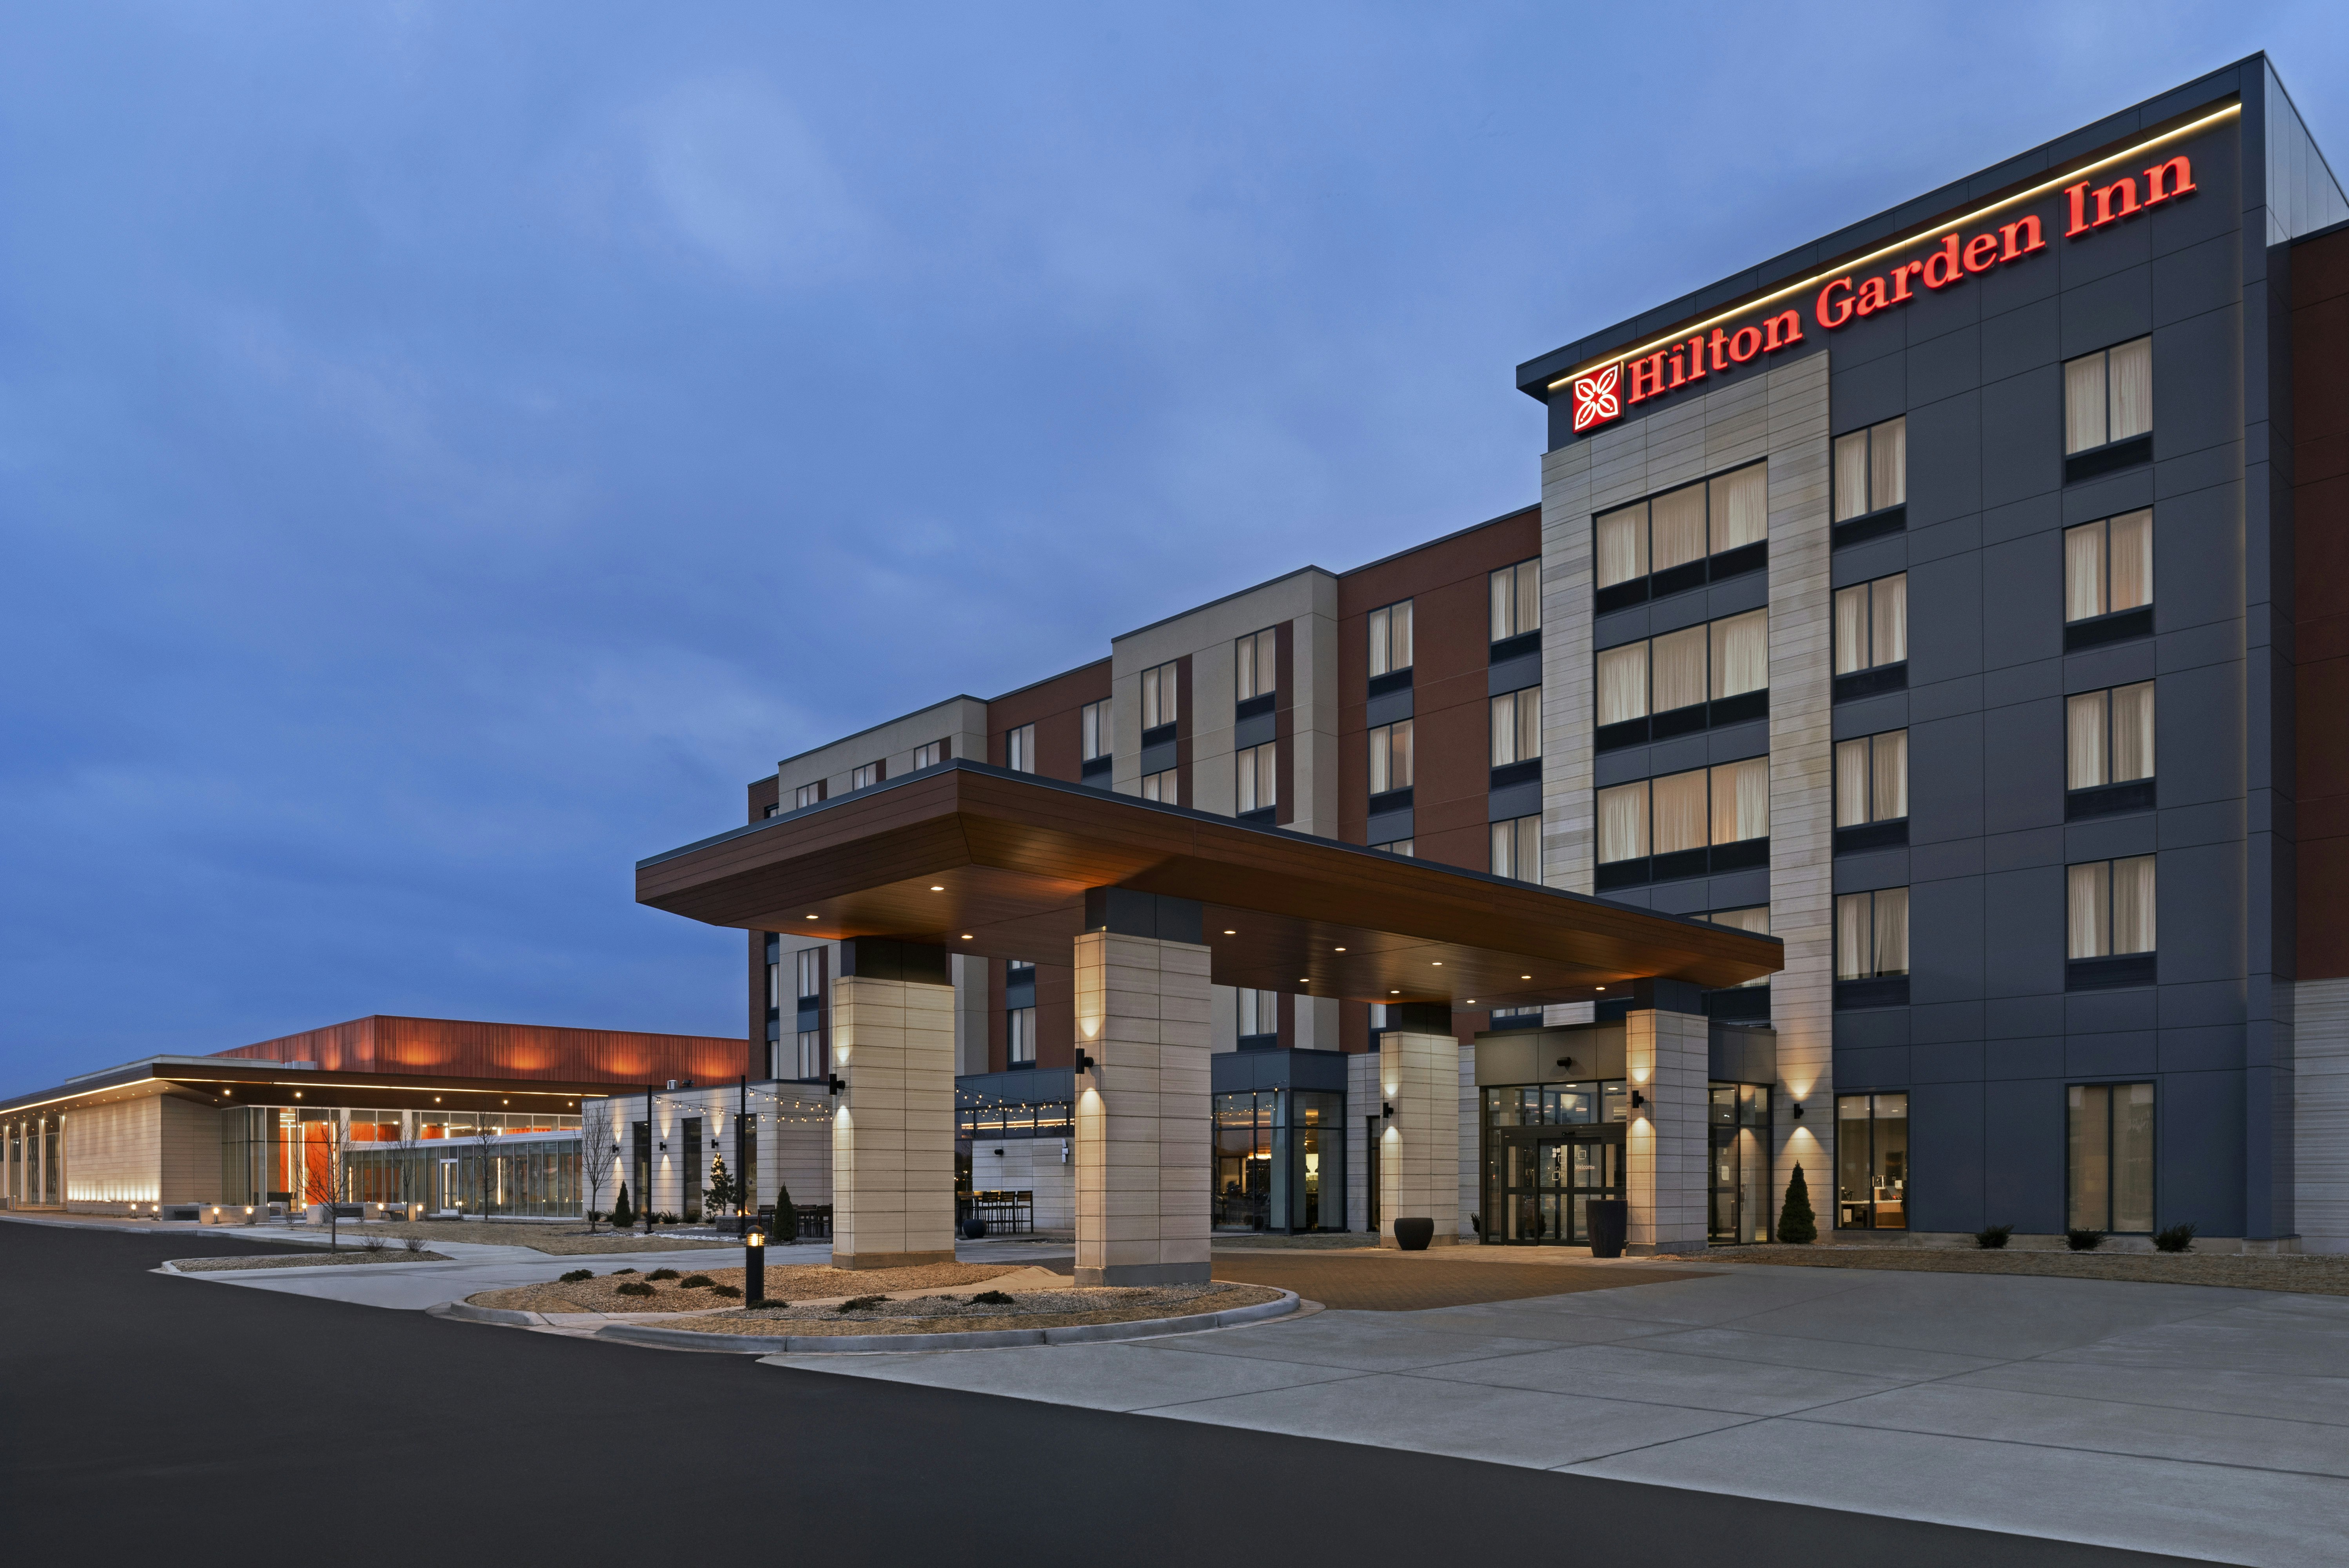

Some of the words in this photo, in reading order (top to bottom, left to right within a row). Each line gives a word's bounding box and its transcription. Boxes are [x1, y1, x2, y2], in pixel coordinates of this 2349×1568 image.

[1628, 310, 1803, 404] Hilton
[1816, 215, 2046, 328] Garden
[2064, 156, 2196, 238] Inn
